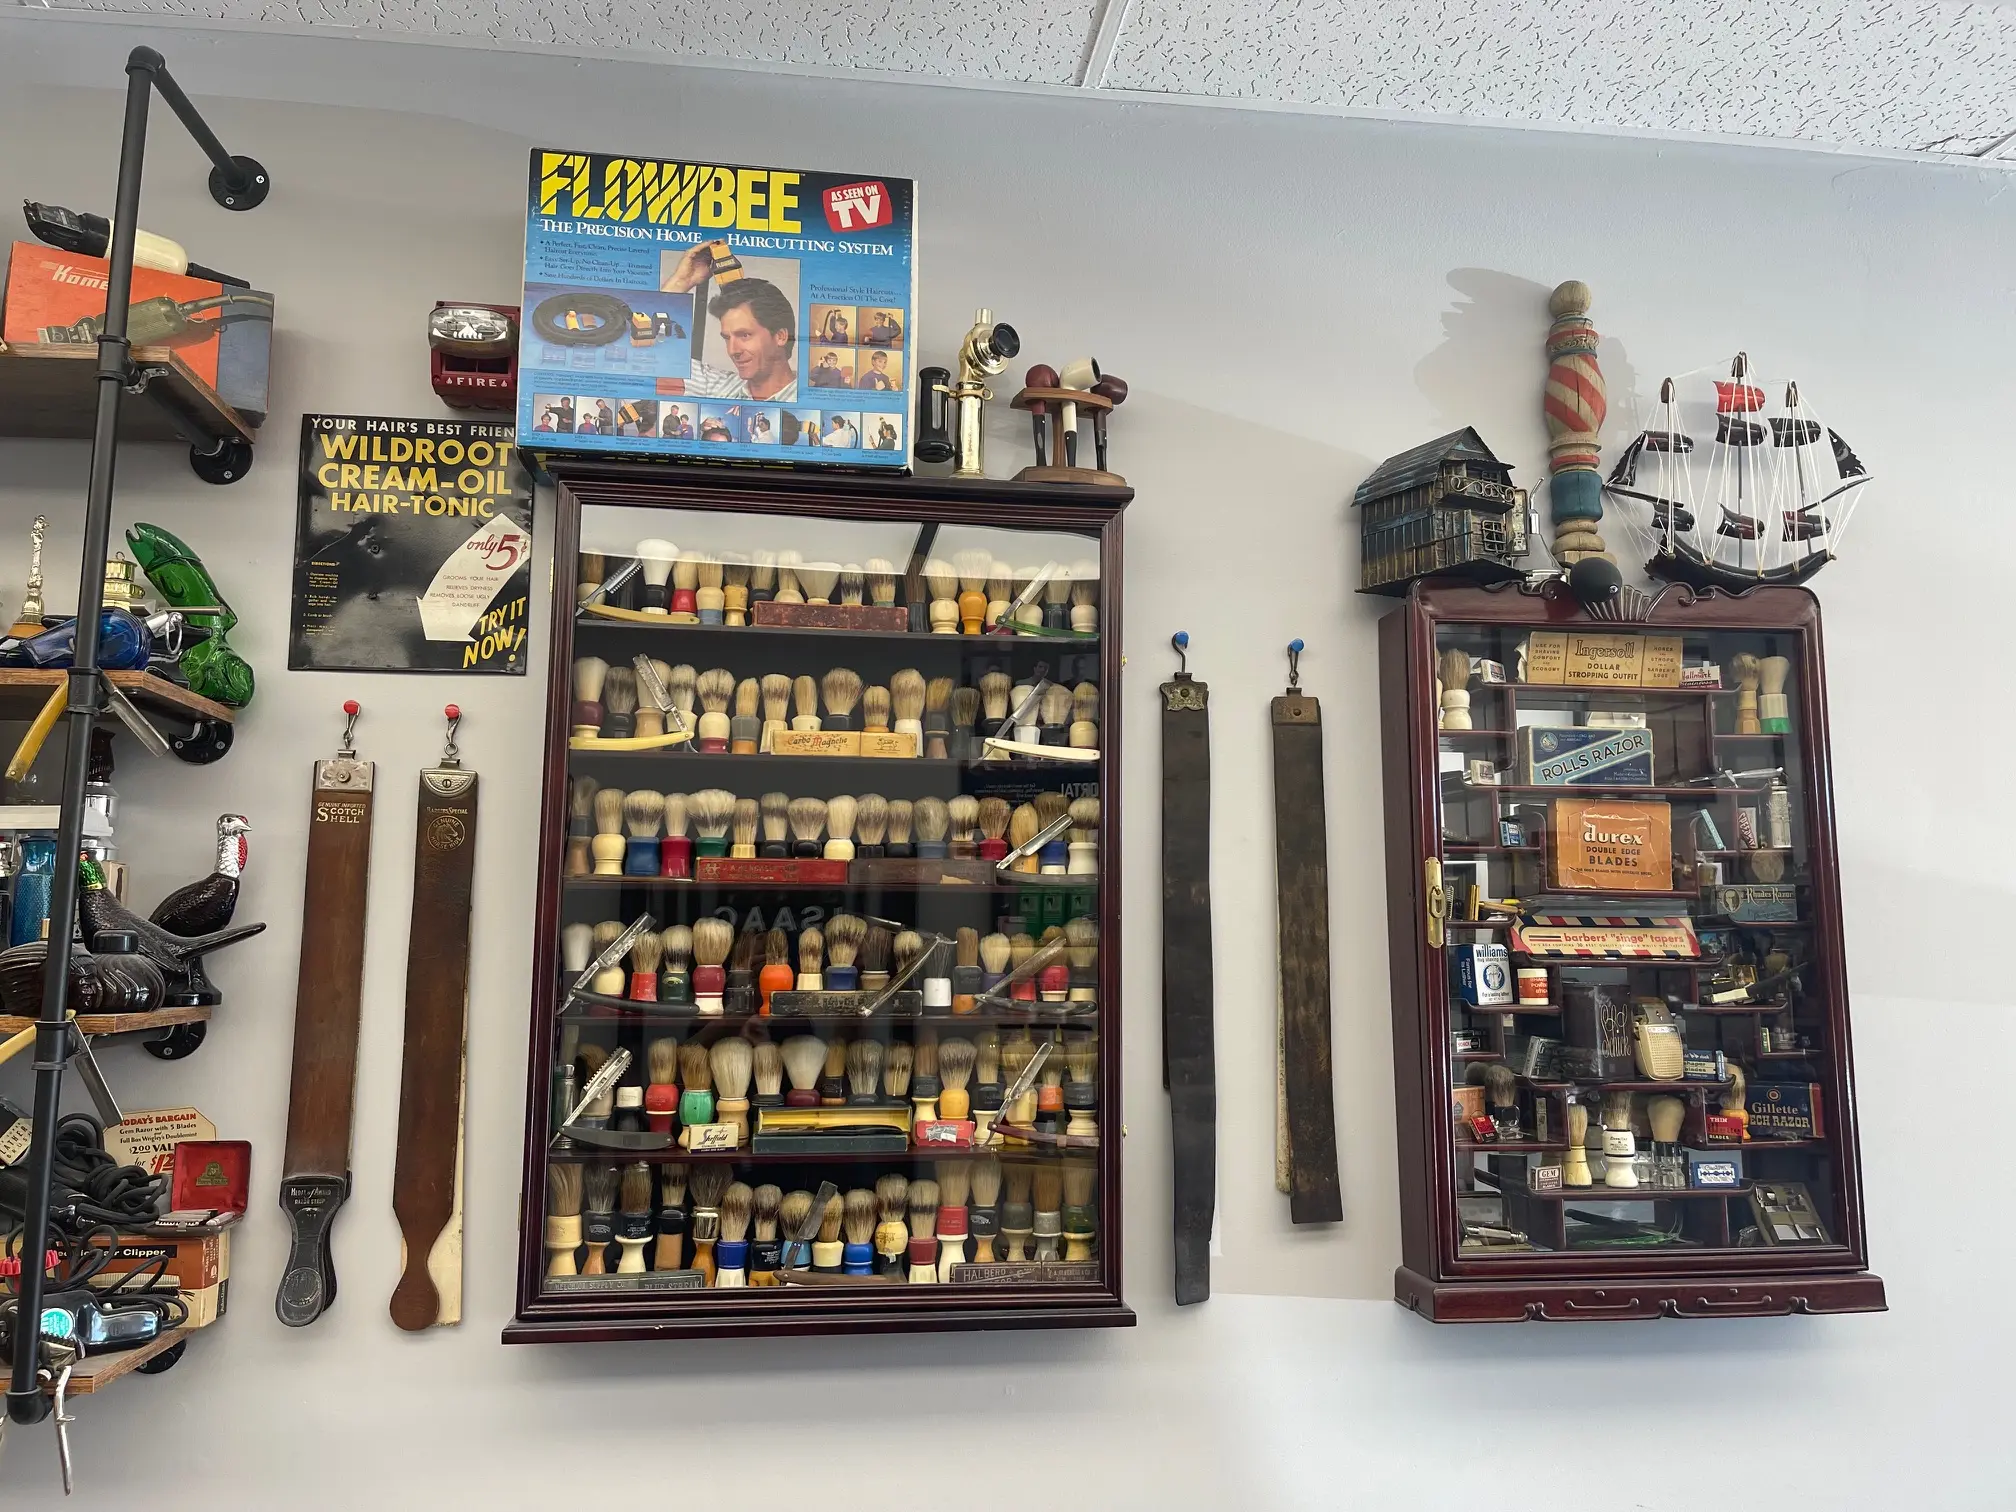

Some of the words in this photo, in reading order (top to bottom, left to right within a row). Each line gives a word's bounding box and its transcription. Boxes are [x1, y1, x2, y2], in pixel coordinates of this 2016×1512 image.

[540, 152, 802, 234] FLOWBEE
[831, 191, 842, 201] AS
[843, 187, 864, 200] SEEN
[865, 185, 878, 196] ON
[831, 195, 881, 228] TV
[540, 219, 573, 234] THE
[576, 222, 653, 240] PRECISION
[656, 229, 702, 244] HOME
[727, 232, 835, 253] HAIRCUTTING
[839, 240, 893, 256] SYSTEM
[456, 377, 498, 387] FIRE
[311, 418, 357, 431] YOUR
[366, 421, 418, 434] HAIR'S
[427, 423, 462, 436] BEST
[470, 425, 515, 438] FRIEN
[320, 433, 513, 467] WILDROOT
[317, 462, 512, 495] CREAM-OIL
[331, 492, 494, 518] HAIR-TONIC
[467, 533, 498, 560] only
[478, 604, 507, 636] TRY
[510, 596, 527, 620] IT
[462, 627, 527, 669] NOW!
[1575, 639, 1635, 660] Ingersoll
[1568, 671, 1609, 679] STROPPING
[1587, 663, 1620, 671] DOLLAR
[1541, 754, 1590, 781] ROLLS
[1592, 735, 1644, 762] RAZOR
[1583, 821, 1643, 845] durex
[1586, 846, 1616, 854] DOUBLE
[1589, 856, 1638, 867] BLADES
[1563, 932, 1608, 942] barbers'
[1610, 933, 1648, 943] "singe"
[1650, 934, 1685, 945] tapers
[1476, 944, 1508, 957] williams
[1751, 1102, 1798, 1114] Gillette
[156, 1113, 197, 1123] BARGAIN
[1750, 1114, 1771, 1126] ECH
[1773, 1115, 1810, 1128] RAZOR
[135, 1157, 145, 1167] for
[123, 1248, 166, 1259] Clipper
